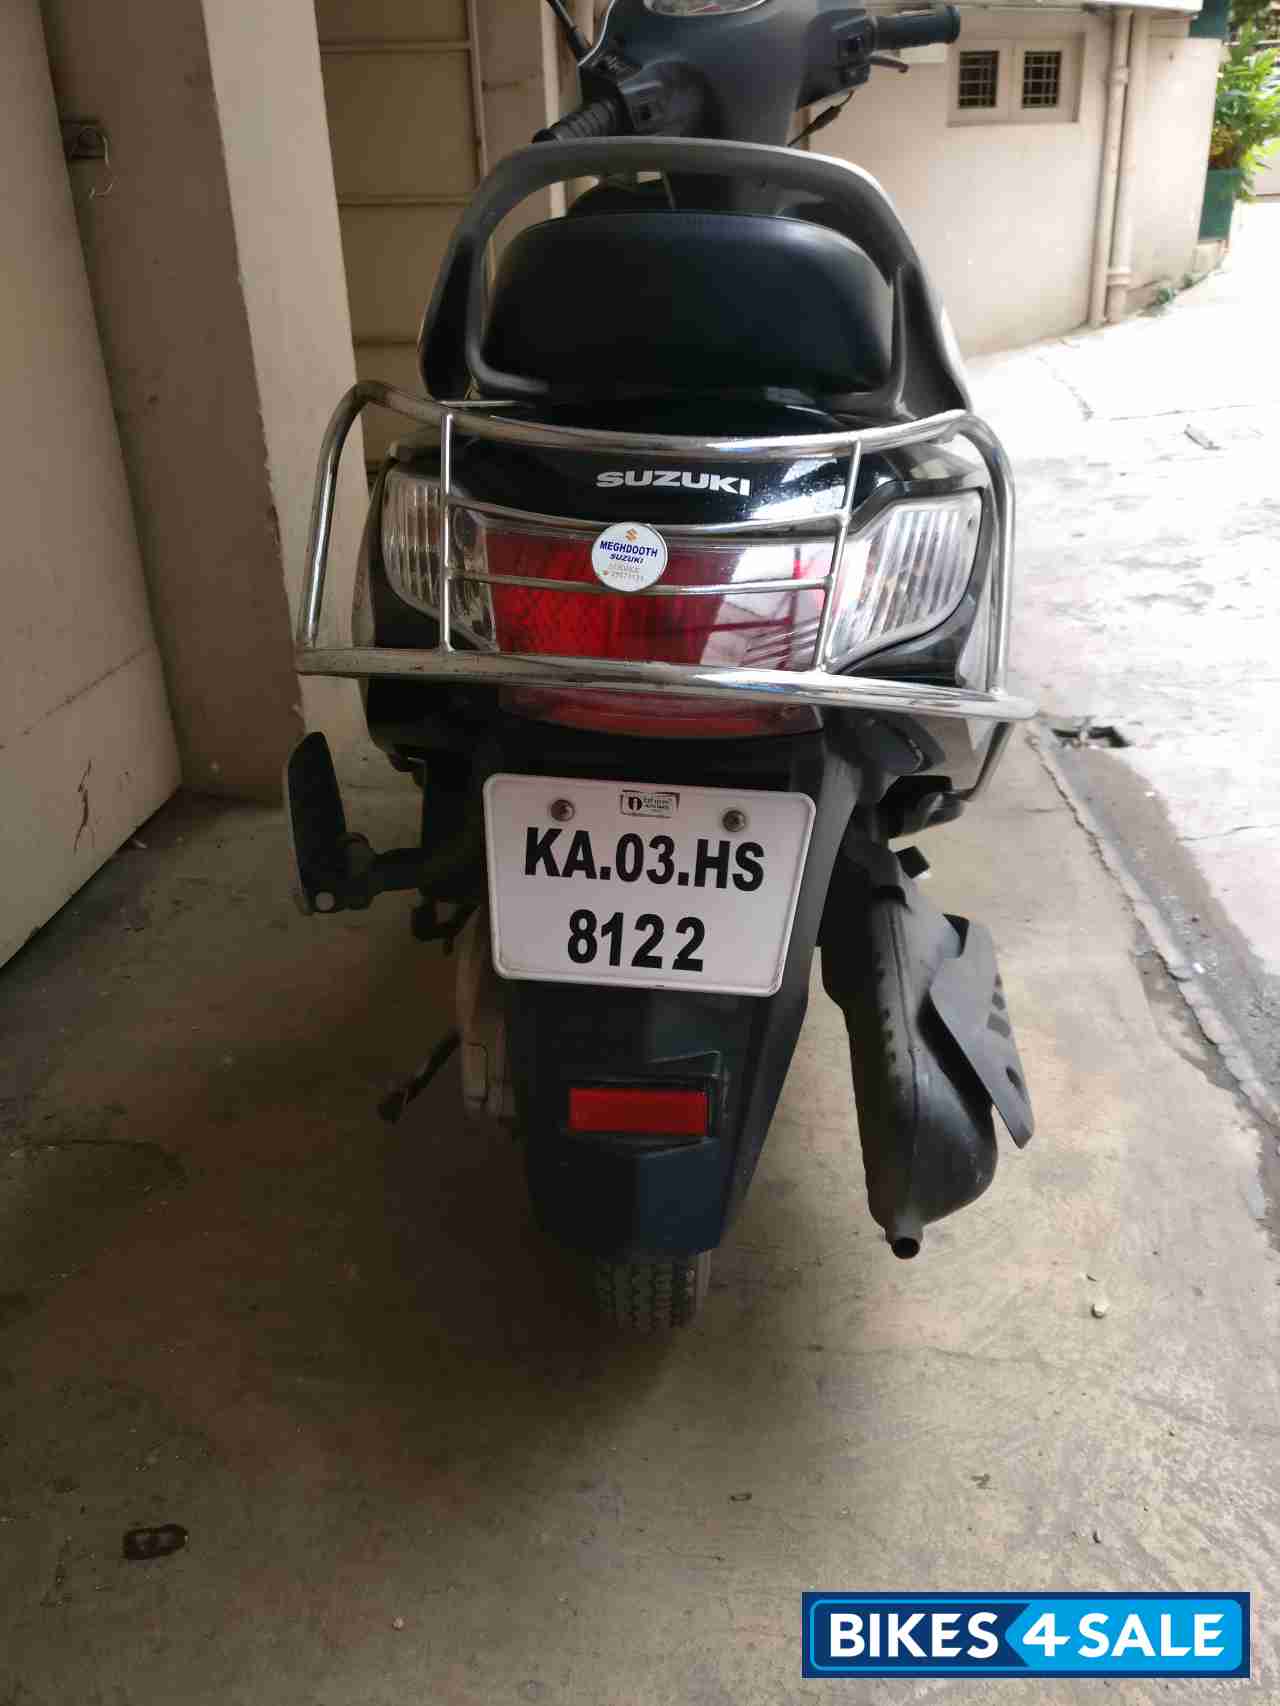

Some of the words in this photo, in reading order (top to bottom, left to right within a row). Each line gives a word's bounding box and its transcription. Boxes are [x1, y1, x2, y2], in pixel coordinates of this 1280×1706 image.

[596, 470, 751, 496] SUZUKI
[599, 540, 658, 558] MEGHDOOTH
[609, 553, 644, 564] SUZUKI
[525, 826, 765, 892] KA.03.HS
[567, 908, 706, 972] 8122
